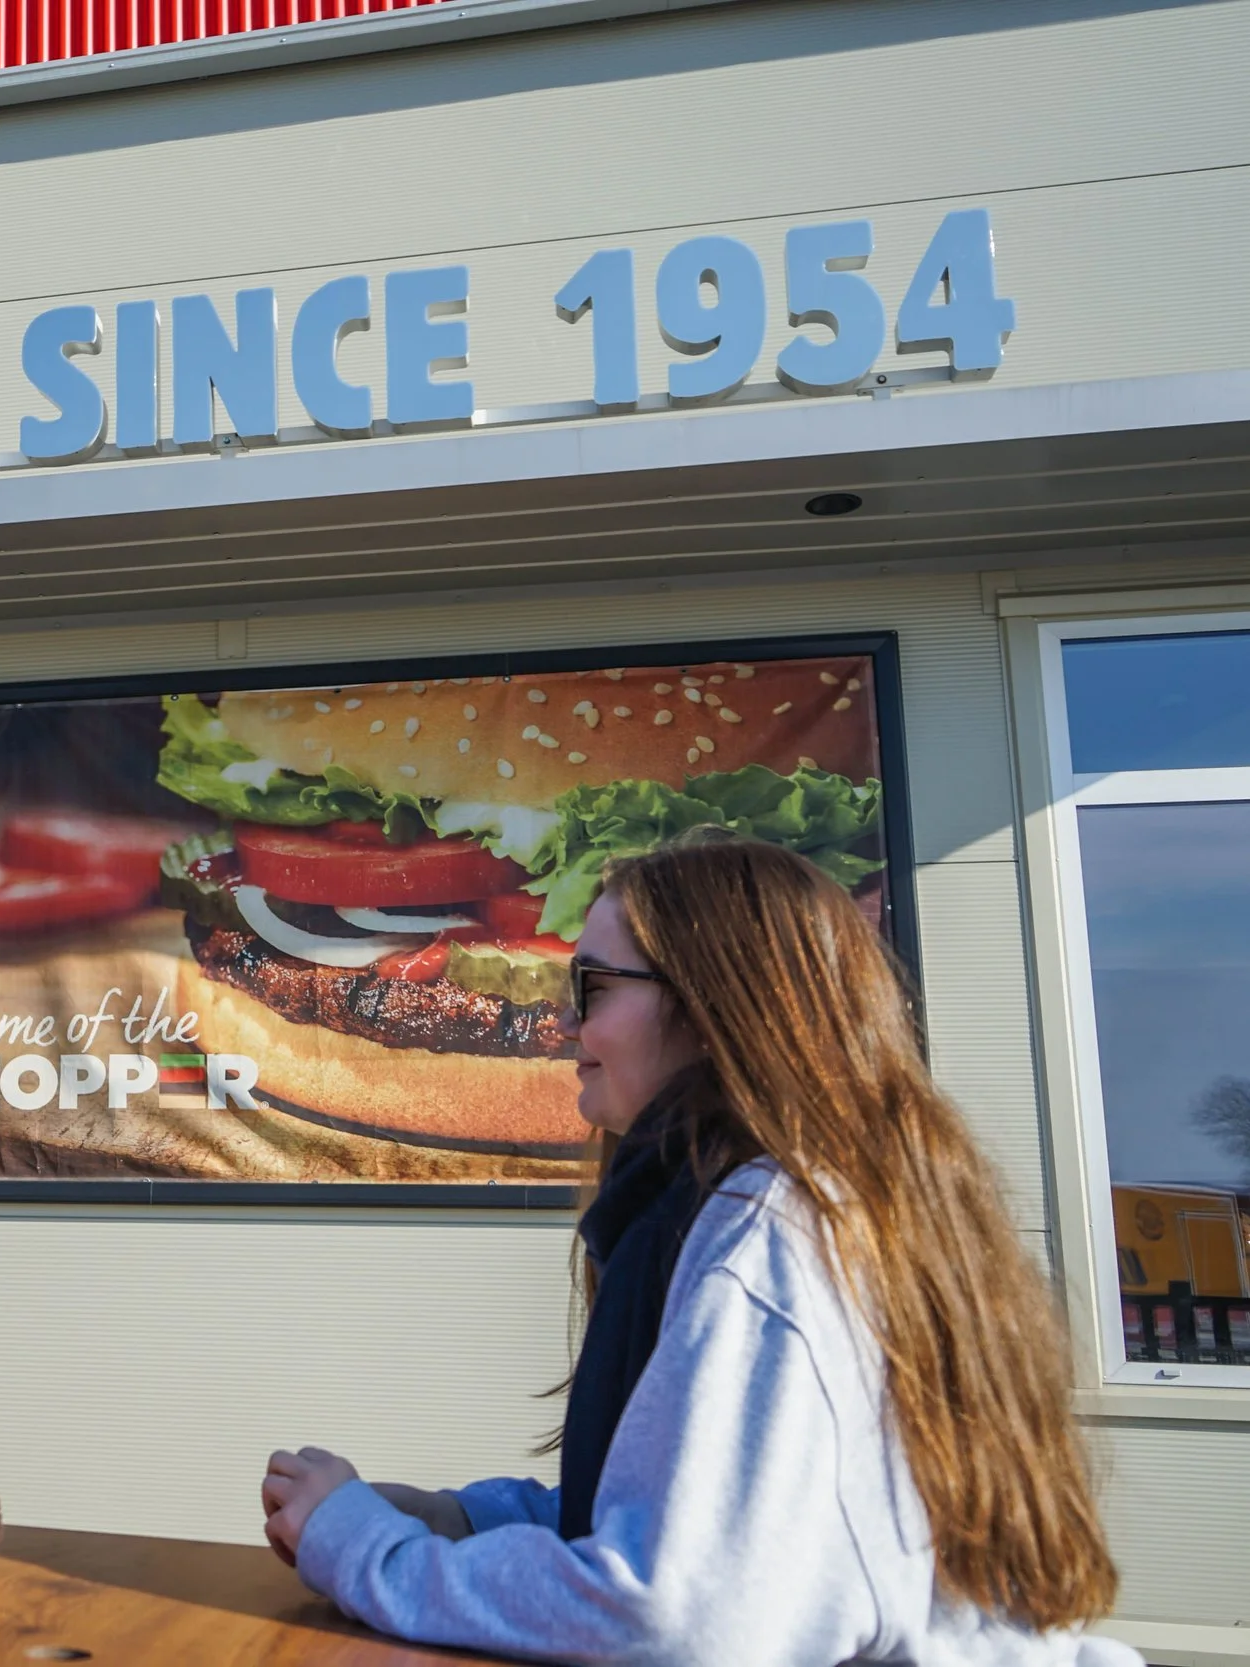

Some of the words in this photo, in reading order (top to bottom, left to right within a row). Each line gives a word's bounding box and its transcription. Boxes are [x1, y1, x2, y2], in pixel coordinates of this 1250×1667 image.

[20, 265, 475, 460] SINCE
[554, 208, 1016, 408] 1954
[66, 987, 123, 1053] of
[122, 986, 200, 1044] the
